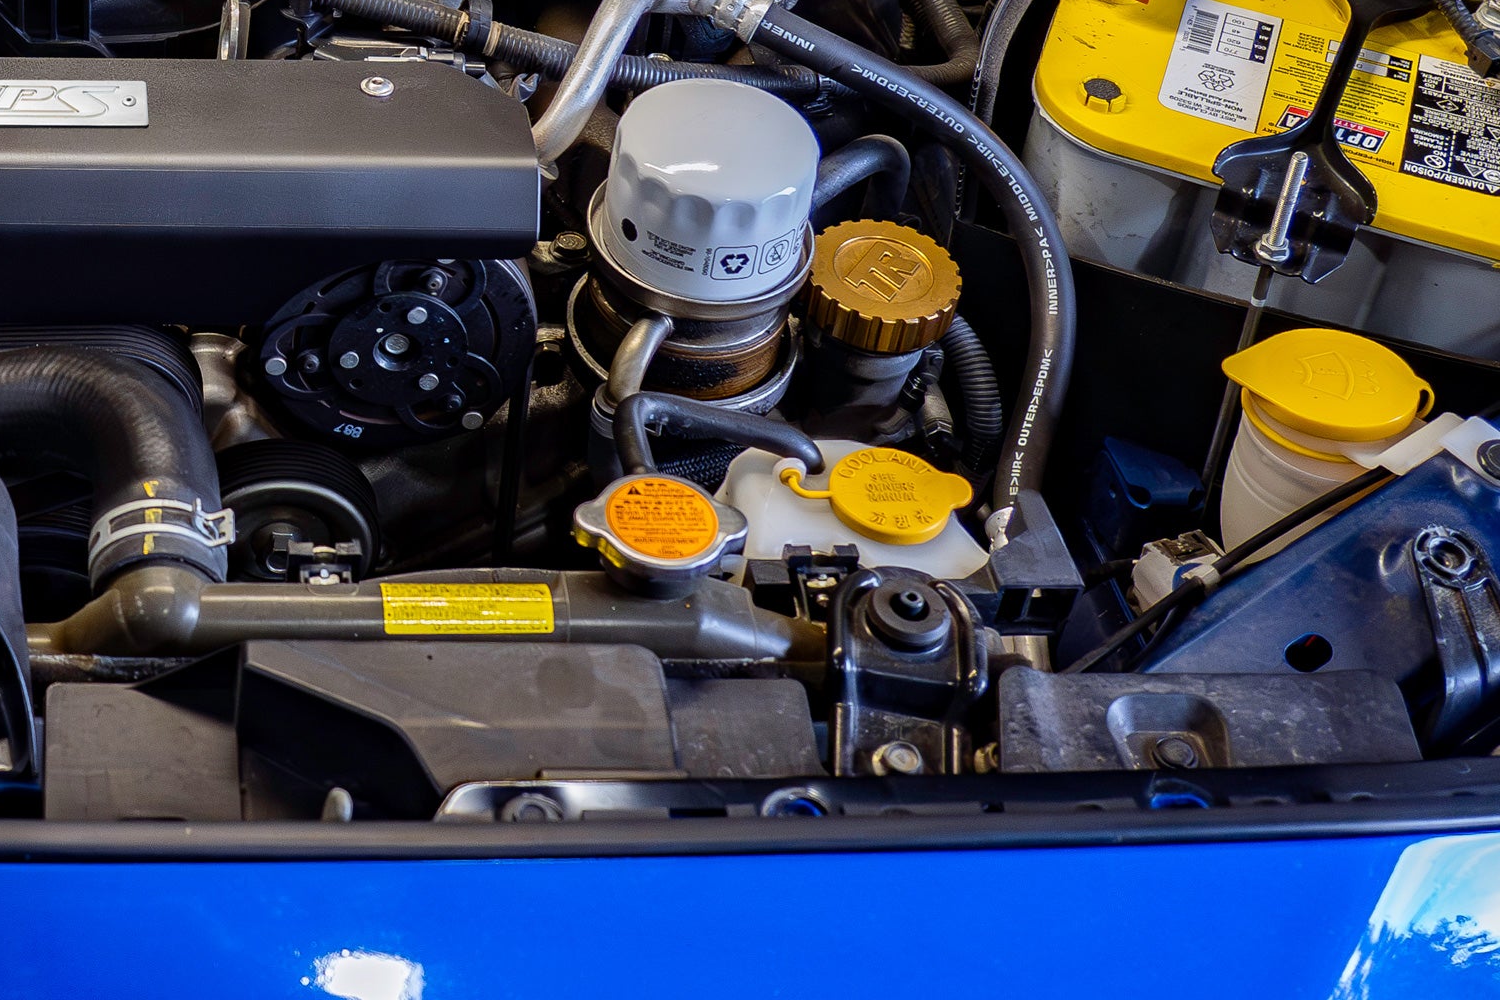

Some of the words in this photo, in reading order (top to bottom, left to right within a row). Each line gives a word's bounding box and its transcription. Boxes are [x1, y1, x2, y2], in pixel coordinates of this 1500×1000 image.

[759, 18, 816, 52] INNER
[1184, 87, 1208, 97] Battery
[1169, 95, 1193, 105] 53209
[1177, 90, 1243, 112] NON-SPILLABLE
[1177, 102, 1208, 114] CLARIOS
[1428, 118, 1446, 126] ACID
[1410, 127, 1445, 140] SMOKING
[1413, 139, 1442, 151] SPARKS
[1414, 134, 1444, 146] FLAMES
[1460, 150, 1500, 165] XPLOSIVE
[1403, 162, 1485, 191] DANGER/POISON
[838, 451, 932, 478] COOLANT
[870, 472, 896, 481] SEE
[865, 482, 915, 493] OWNERS
